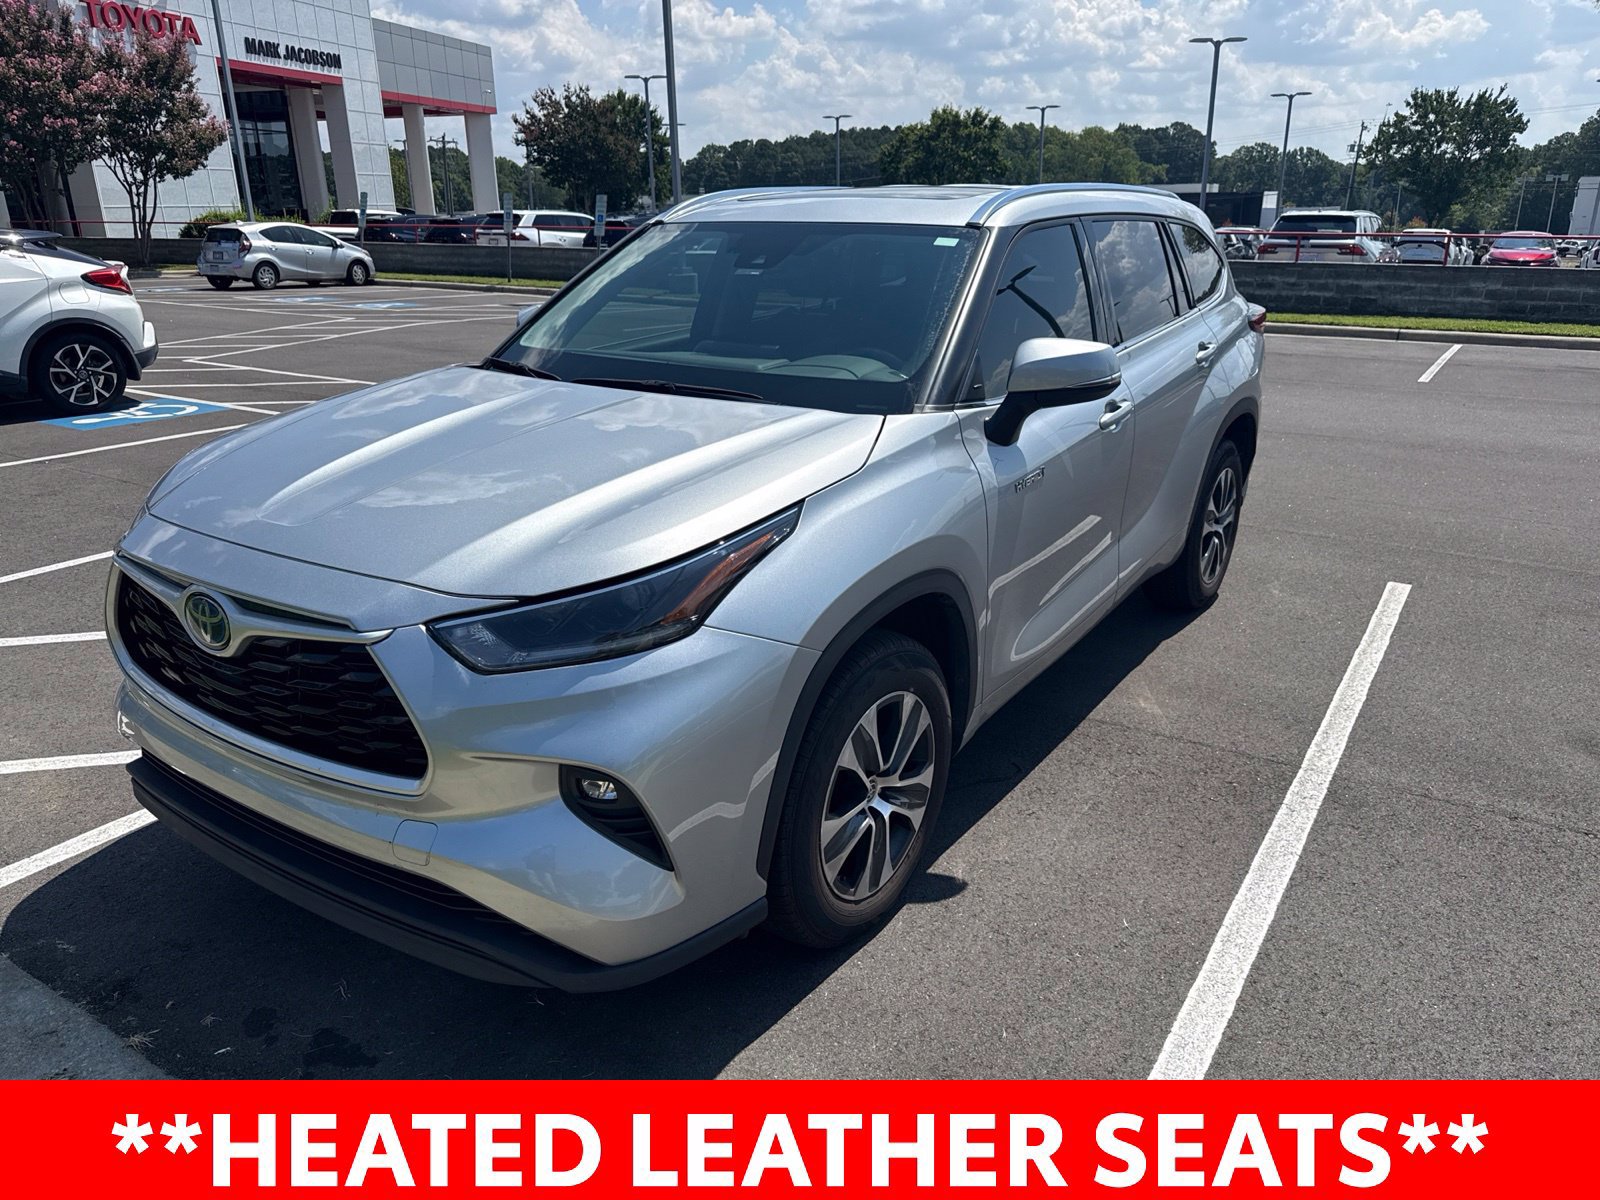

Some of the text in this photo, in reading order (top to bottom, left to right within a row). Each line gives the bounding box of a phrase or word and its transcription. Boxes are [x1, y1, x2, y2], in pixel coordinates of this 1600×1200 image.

[79, 0, 202, 45] TOYOTA
[244, 36, 342, 69] MARK JACOBSON
